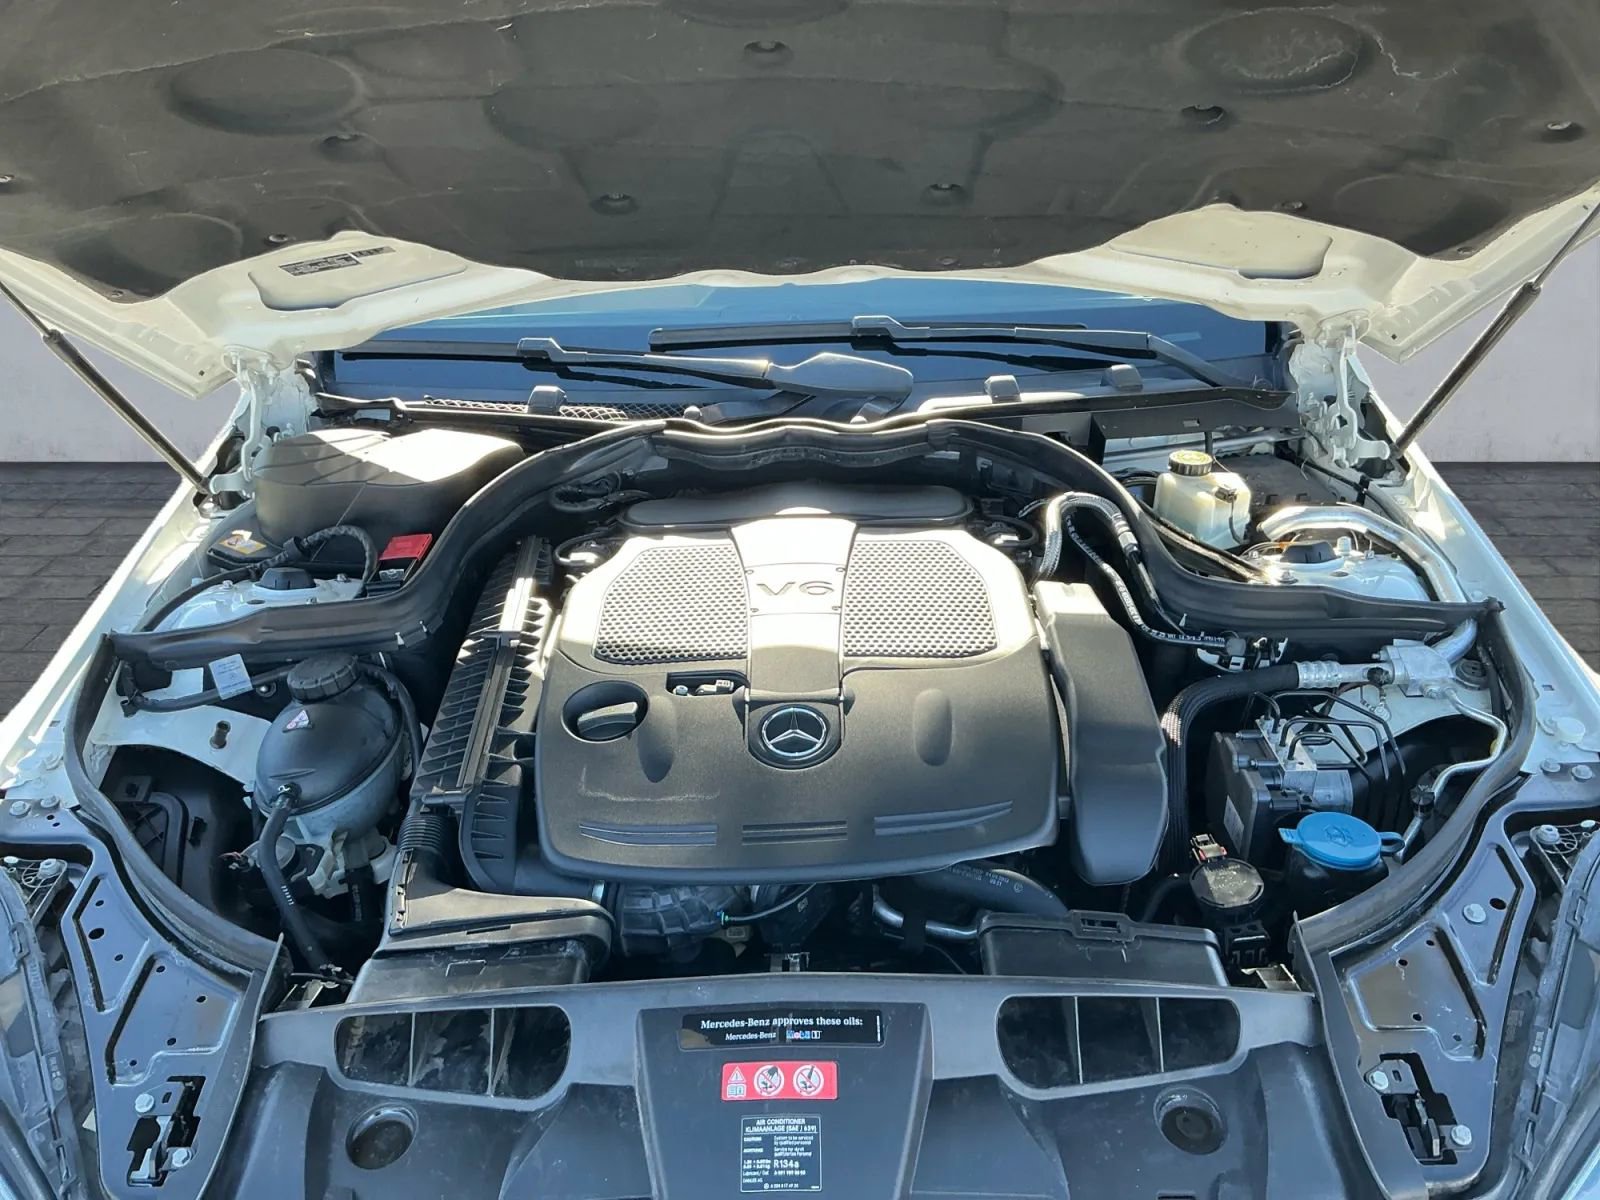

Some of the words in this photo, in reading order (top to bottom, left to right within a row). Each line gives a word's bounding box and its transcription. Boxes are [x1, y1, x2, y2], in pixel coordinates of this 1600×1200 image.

[756, 580, 834, 597] V6
[701, 1018, 770, 1029] Mercedes-Benz
[772, 1016, 814, 1028] approves
[816, 1016, 842, 1026] these
[843, 1016, 863, 1026] oils:
[725, 1031, 777, 1041] Mercedes-Benz
[745, 1125, 785, 1133] KLIMAANLAGE
[774, 1159, 799, 1168] R134a
